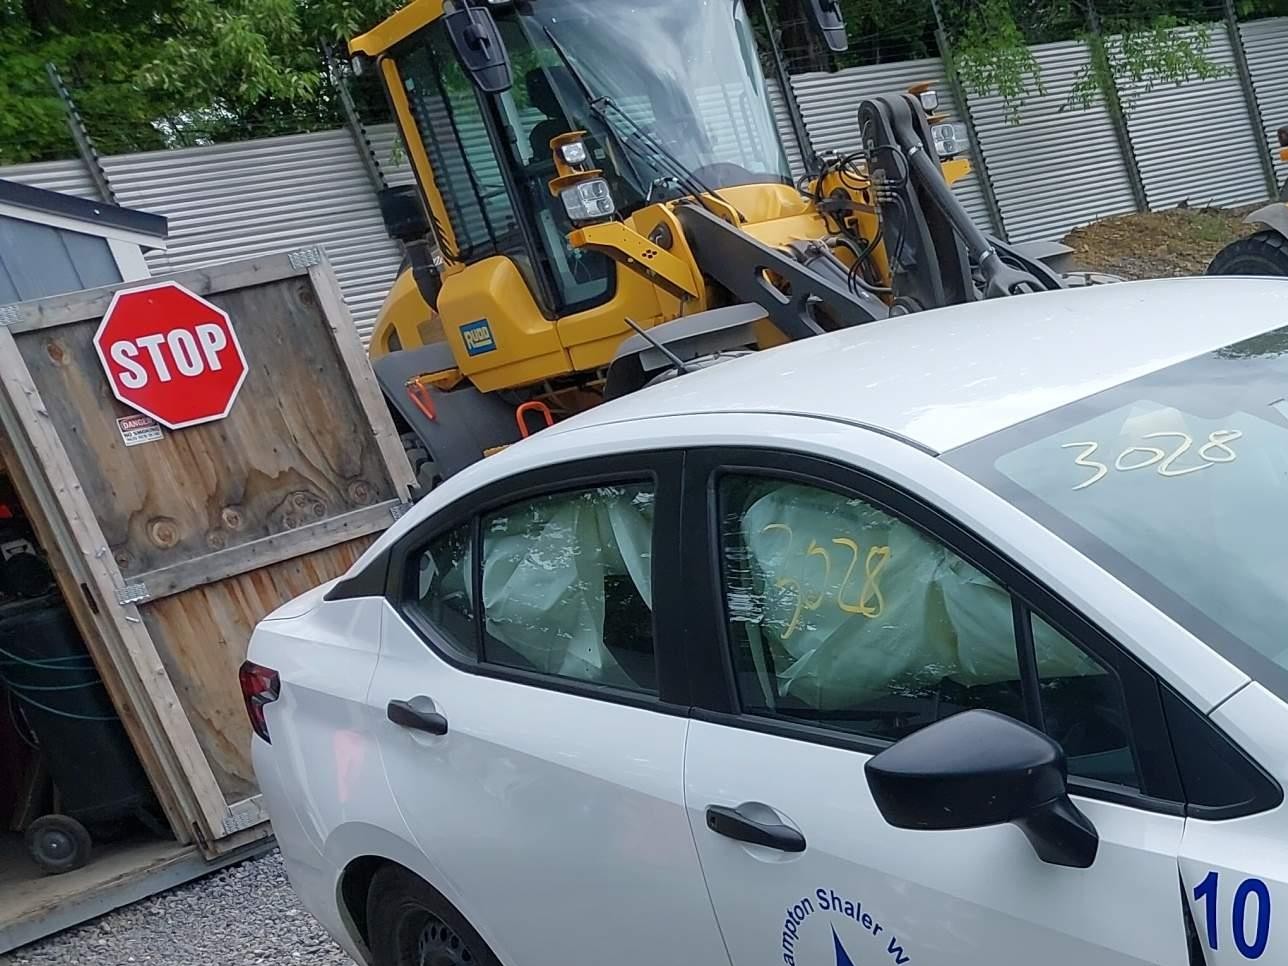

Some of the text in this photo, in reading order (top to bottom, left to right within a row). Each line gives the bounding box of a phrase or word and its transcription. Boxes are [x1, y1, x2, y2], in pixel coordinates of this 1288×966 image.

[110, 323, 227, 389] STOP
[1060, 430, 1243, 490] 3028
[816, 888, 883, 936] Shaler
[1193, 871, 1271, 960] 10
